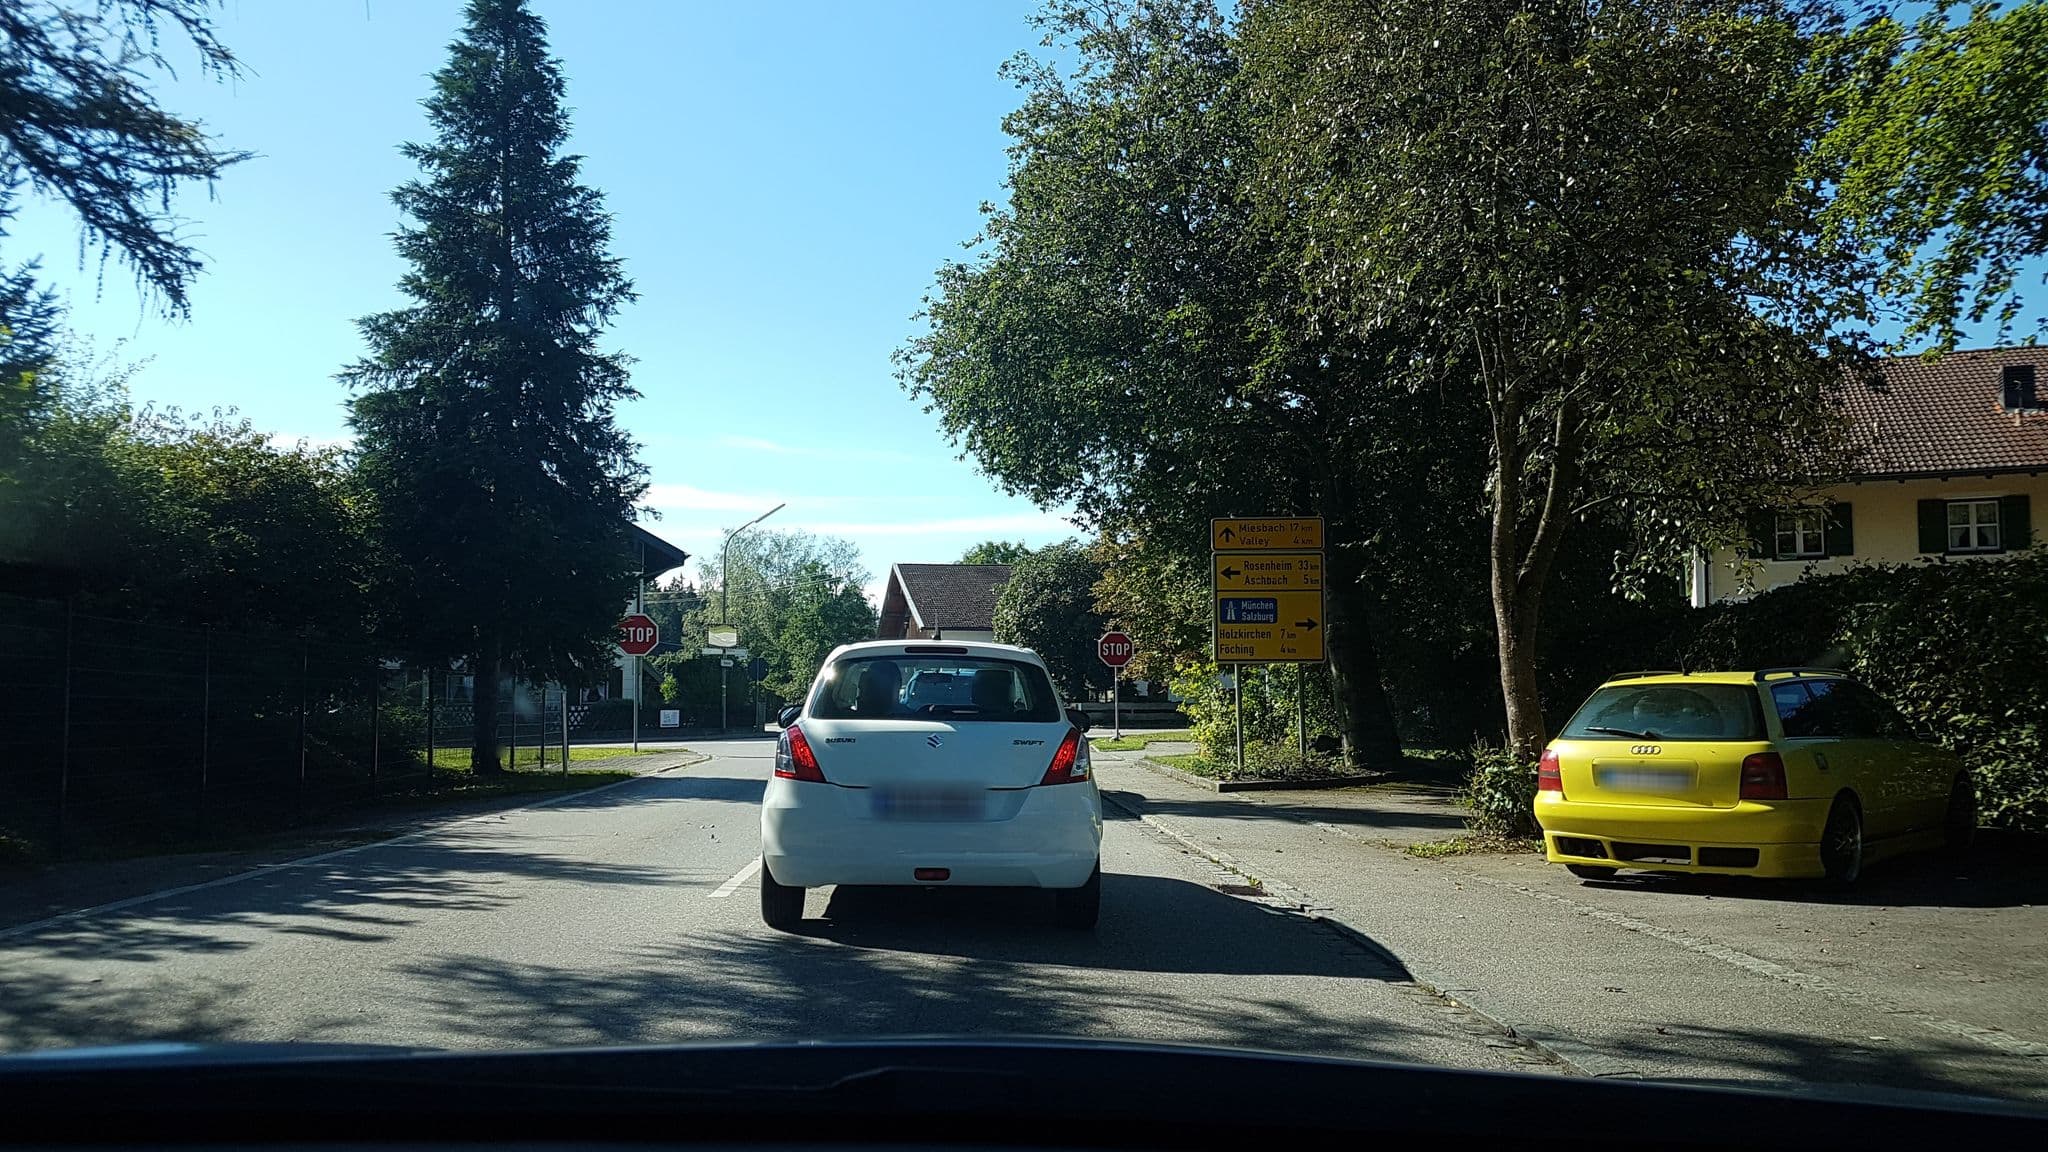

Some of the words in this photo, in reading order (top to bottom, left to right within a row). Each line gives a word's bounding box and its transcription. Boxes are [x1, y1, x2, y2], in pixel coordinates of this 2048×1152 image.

[1239, 524, 1284, 532] Miesbach
[1290, 523, 1298, 532] 17
[1239, 536, 1270, 547] Valley
[1244, 560, 1292, 570] Rosenheim
[1298, 561, 1308, 570] 33
[1244, 575, 1288, 585] Aschbach
[1304, 576, 1309, 584] 5
[1241, 600, 1274, 610] München
[1241, 612, 1274, 622] Salzburg
[1220, 628, 1272, 639] Holzkirchen
[1280, 629, 1286, 639] 7
[1102, 643, 1130, 656] STOP
[1280, 644, 1286, 653] 4
